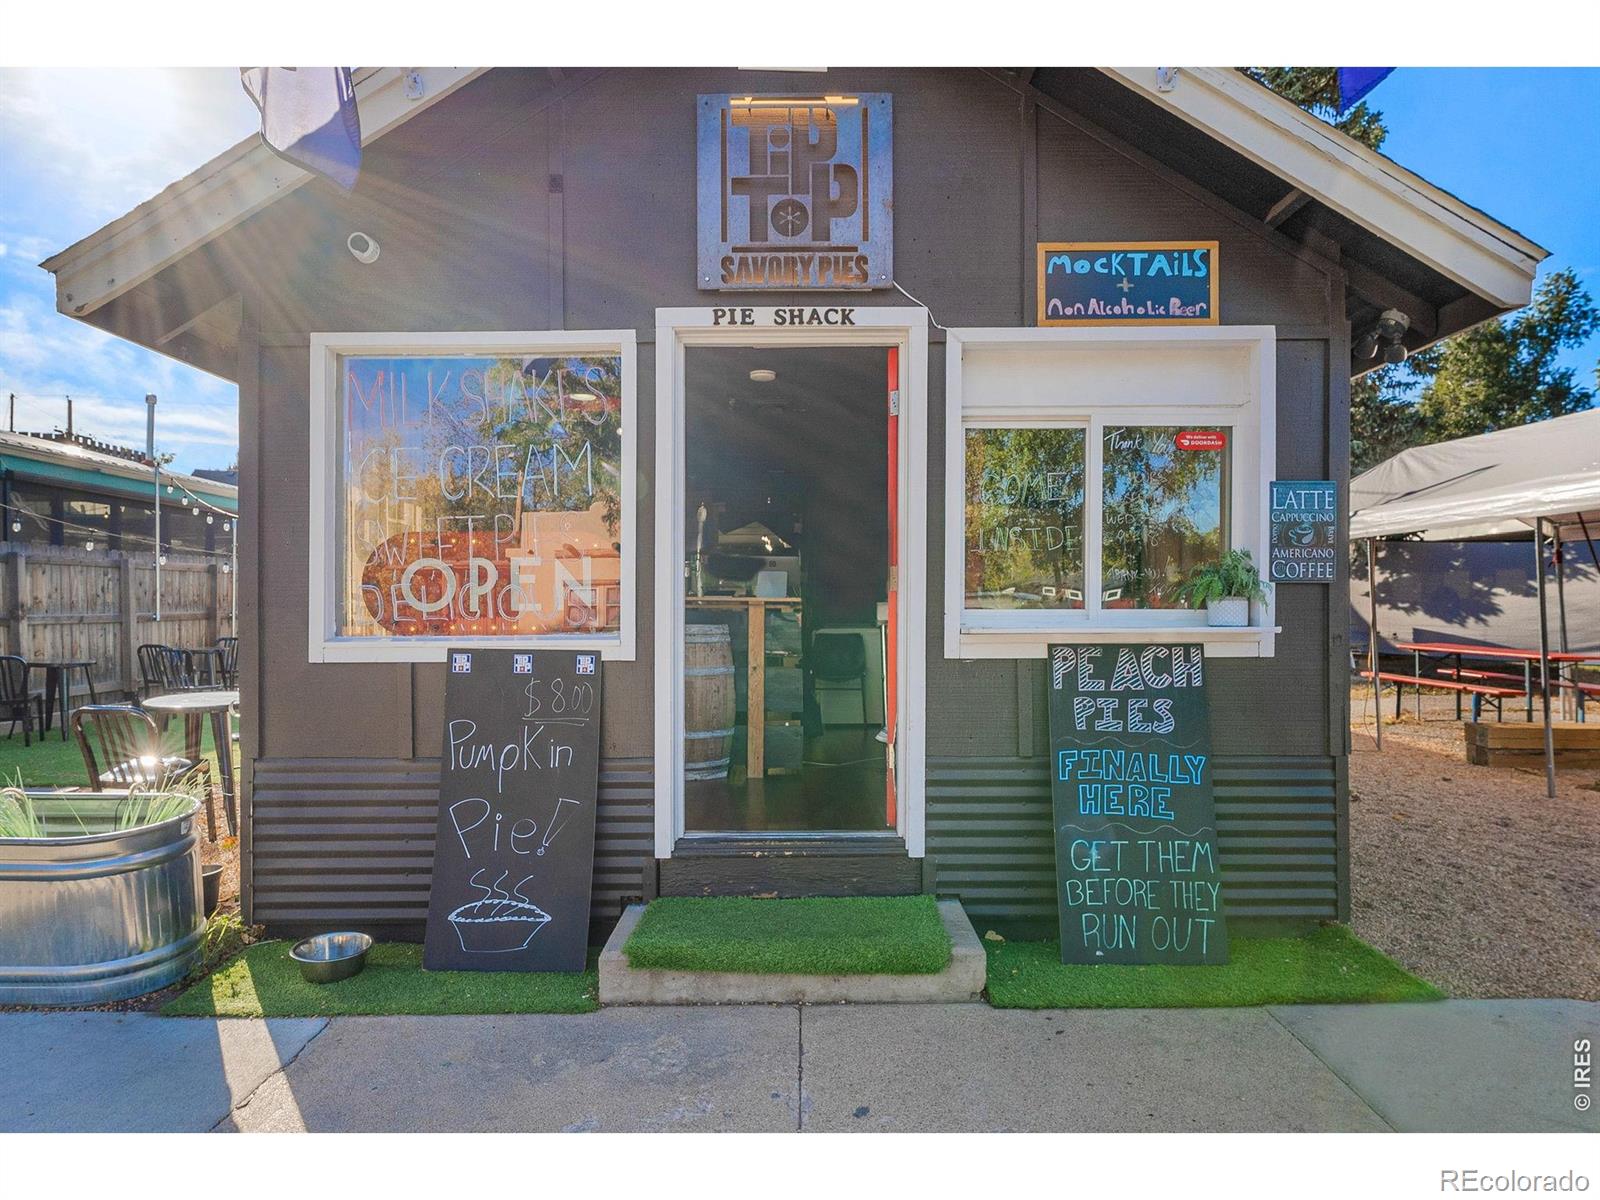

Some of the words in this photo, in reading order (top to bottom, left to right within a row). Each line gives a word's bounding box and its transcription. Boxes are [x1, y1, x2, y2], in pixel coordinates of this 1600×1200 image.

[720, 255, 813, 285] SAVORY
[818, 255, 869, 285] PIES
[712, 308, 756, 326] PIE
[773, 308, 856, 327] SHACK
[1047, 298, 1086, 316] Non
[1169, 297, 1207, 317] Beer
[440, 440, 593, 501] CREAM
[980, 471, 1069, 506] COME
[1272, 487, 1334, 510] LATTE
[1271, 511, 1334, 522] CAPPUCCINO
[971, 526, 1081, 552] INSIDE
[1271, 547, 1334, 559] AMERICANO
[401, 556, 592, 612] OPEN
[1271, 560, 1334, 578] COFFEE
[1053, 646, 1203, 691] PEACH
[1074, 697, 1175, 734] PIES
[1058, 750, 1206, 785] FINALLY
[1079, 784, 1174, 820] HERE
[449, 798, 580, 858] Pie!
[1070, 839, 1129, 872] GET
[1138, 840, 1214, 873] THEM
[1066, 878, 1160, 910] BEFORE
[1170, 880, 1220, 911] THEY
[1082, 913, 1136, 949] RUN
[1152, 916, 1215, 954] OUT
